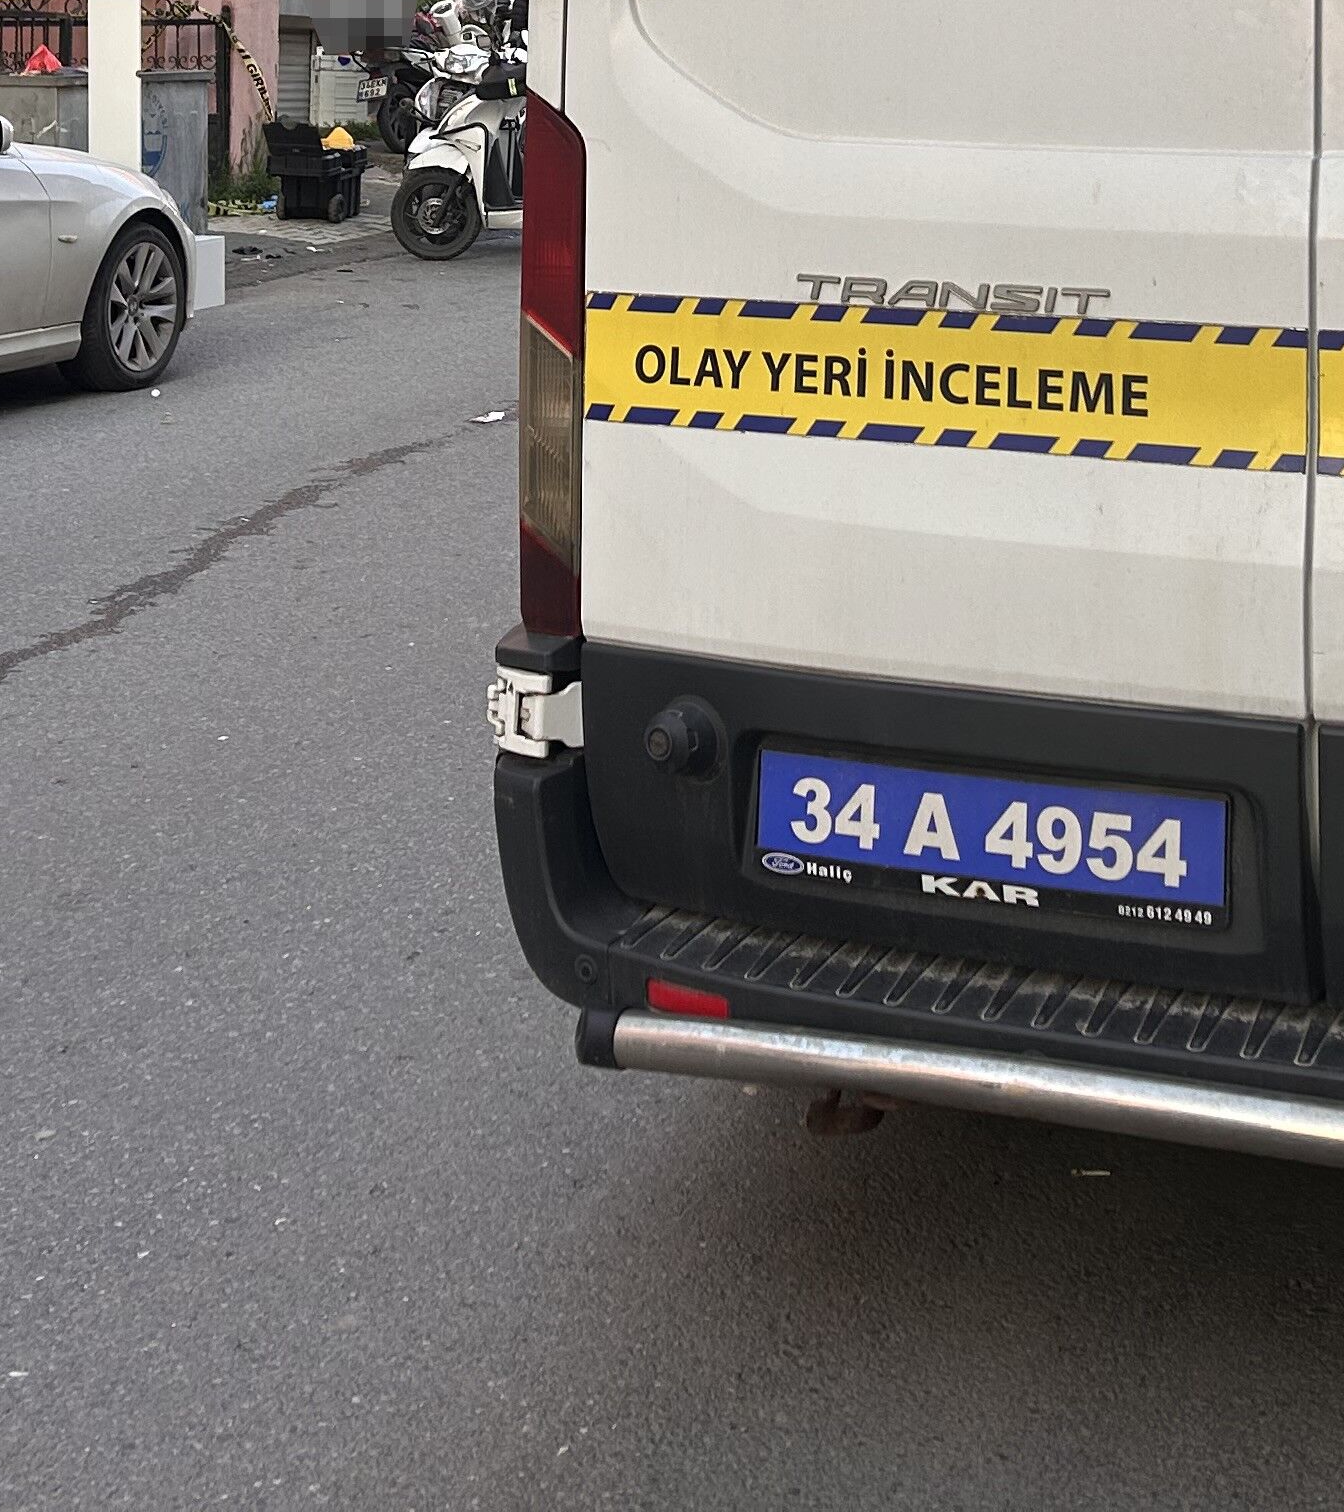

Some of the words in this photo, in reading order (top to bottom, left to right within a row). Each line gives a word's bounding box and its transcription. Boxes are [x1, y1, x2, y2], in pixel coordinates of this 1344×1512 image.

[796, 272, 1111, 315] TRANSIT
[635, 343, 751, 389] OLAY
[762, 347, 868, 398] YERİ
[883, 348, 1150, 418] İNCELEME
[790, 776, 880, 851] 34
[903, 792, 960, 861] A
[984, 801, 1188, 889] 4954
[921, 873, 1040, 908] KAR
